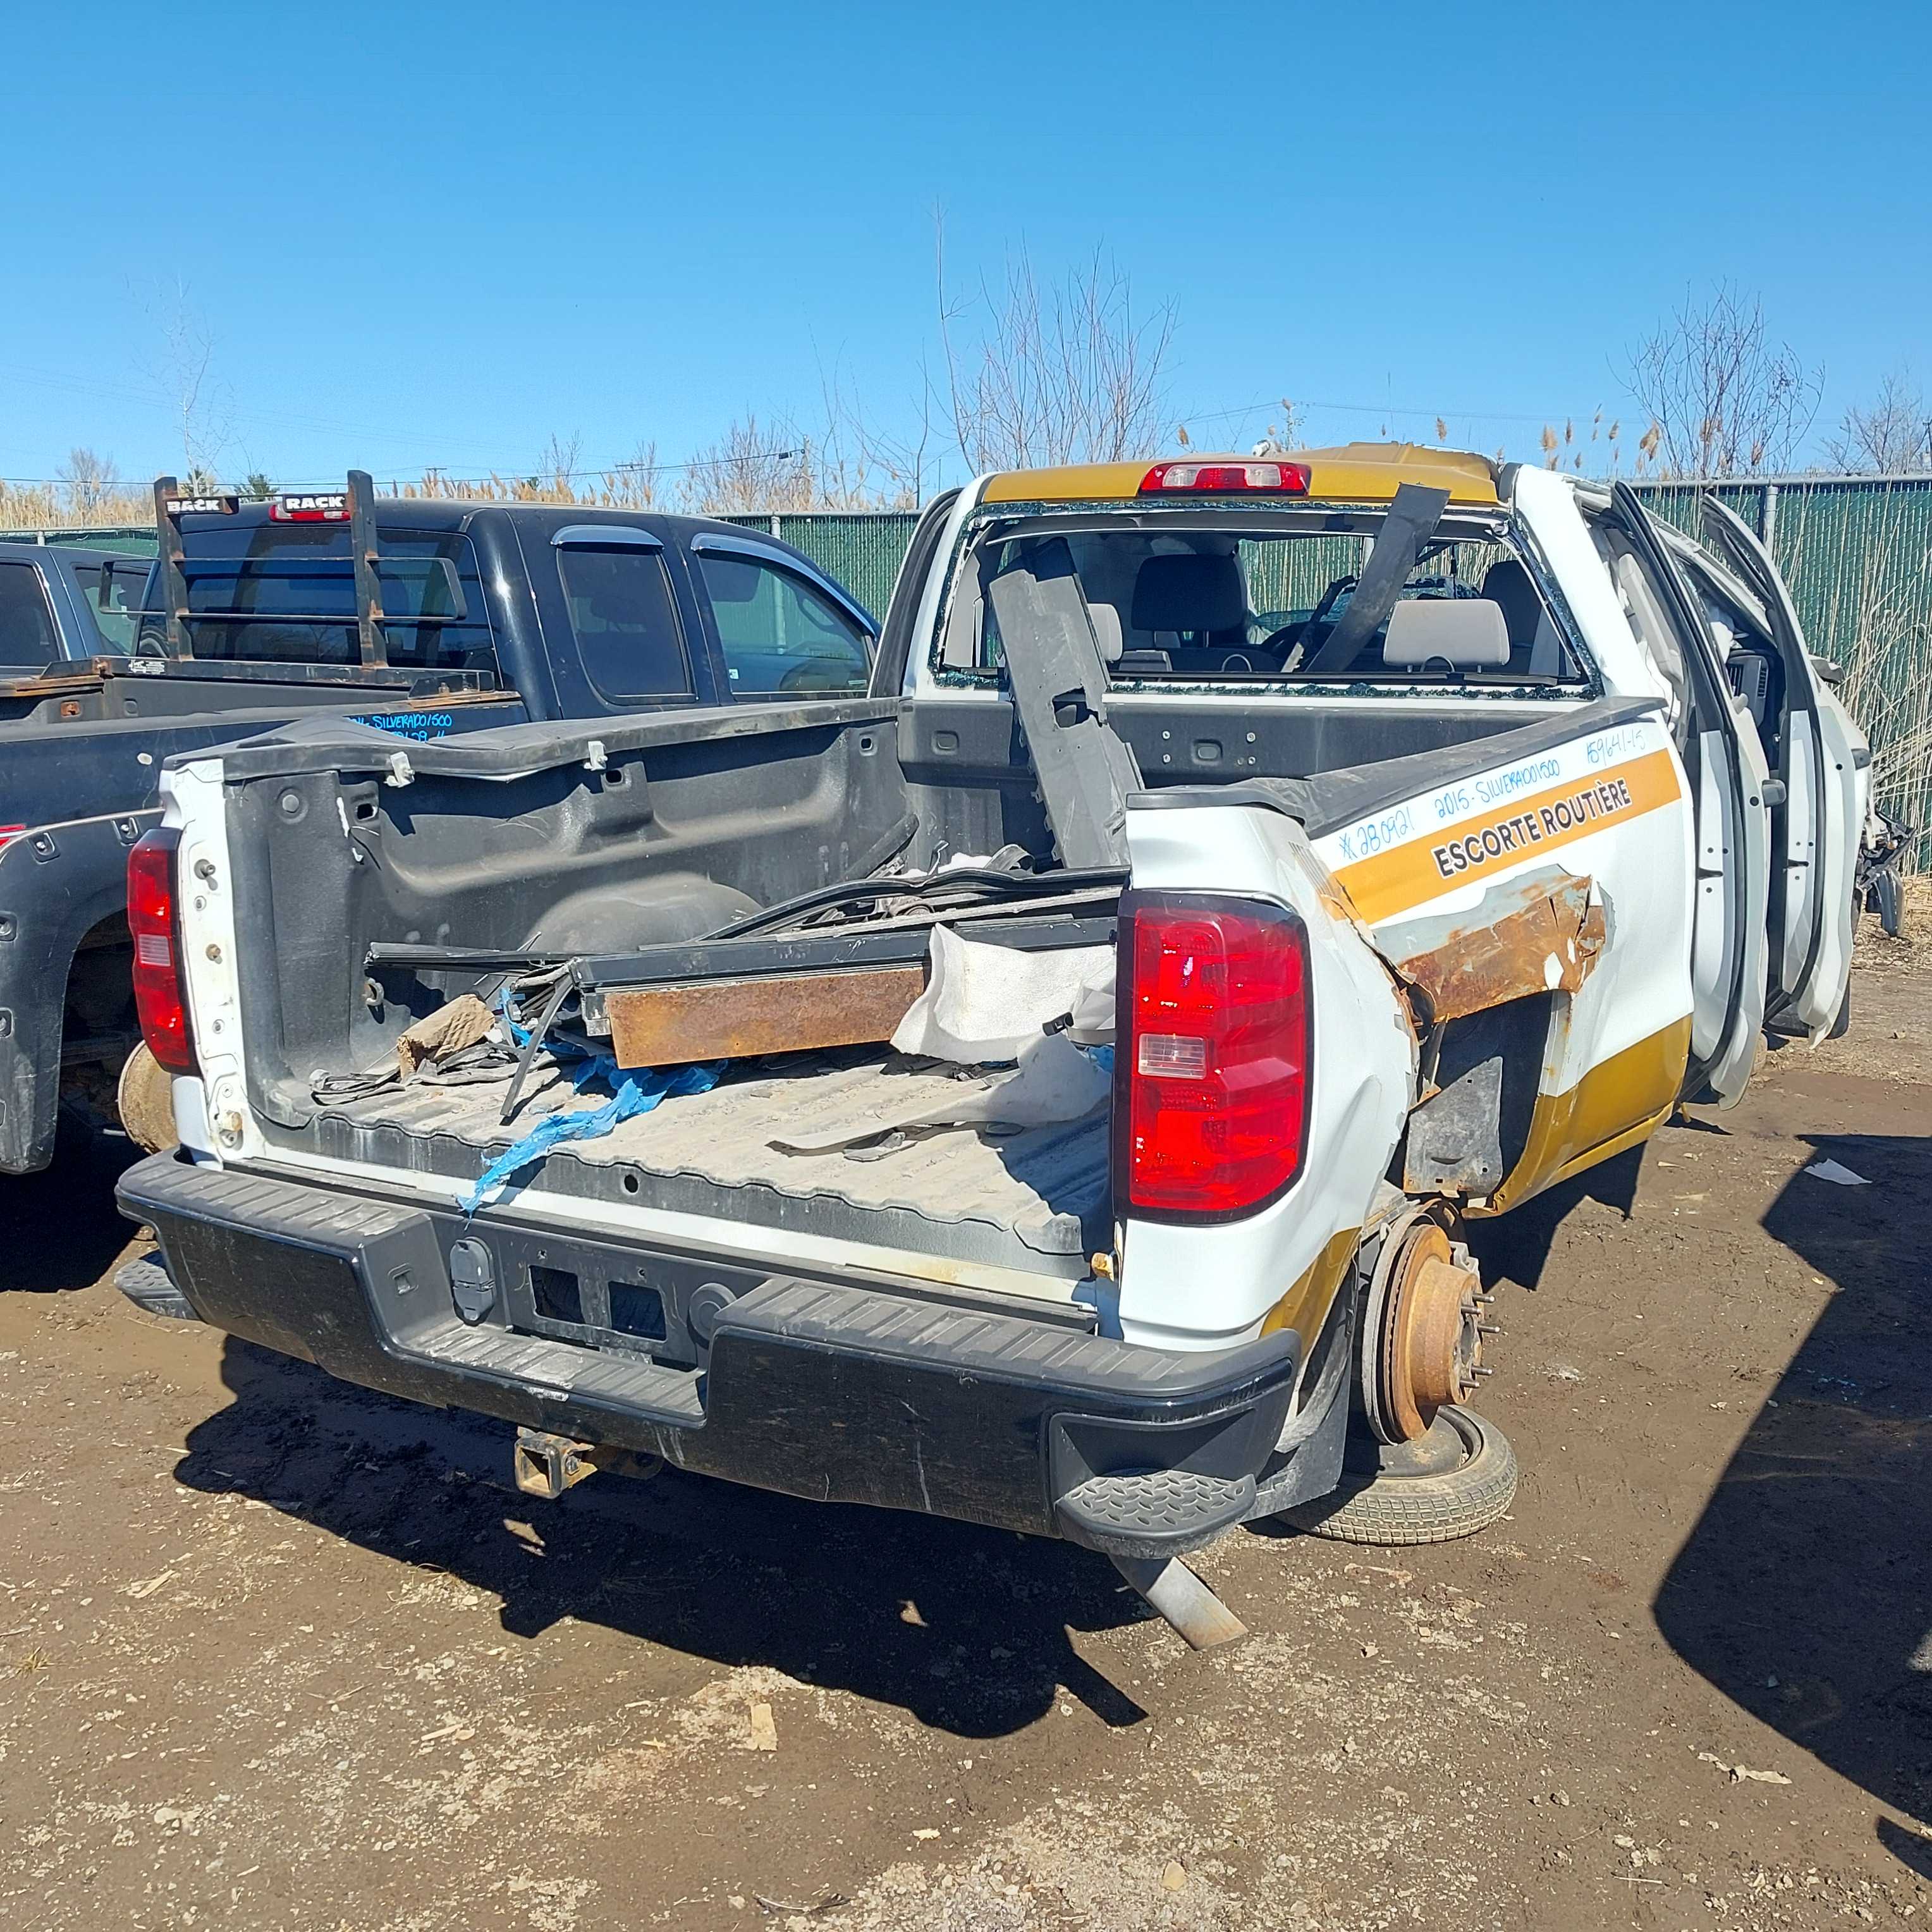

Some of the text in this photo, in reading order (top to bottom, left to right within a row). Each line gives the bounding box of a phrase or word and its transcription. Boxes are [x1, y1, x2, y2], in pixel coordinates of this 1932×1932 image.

[166, 496, 343, 513] BACK RACK
[1432, 778, 1632, 877] ESCORTE ROUTIÈRE
